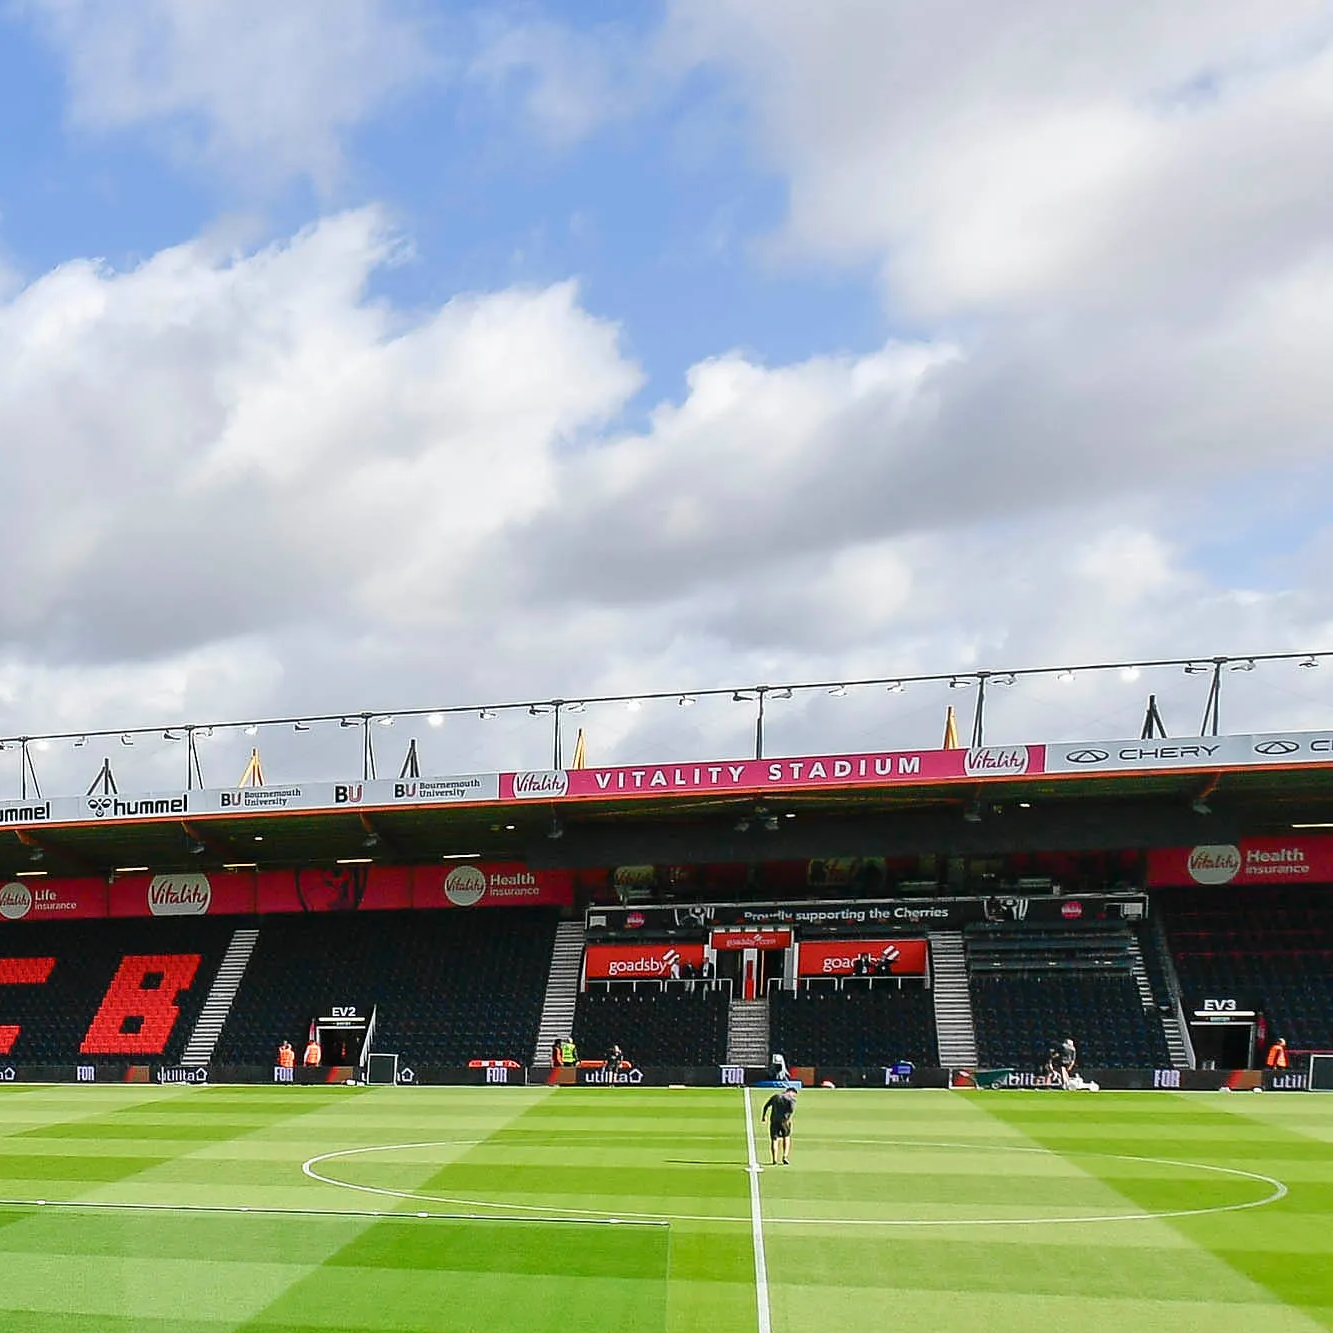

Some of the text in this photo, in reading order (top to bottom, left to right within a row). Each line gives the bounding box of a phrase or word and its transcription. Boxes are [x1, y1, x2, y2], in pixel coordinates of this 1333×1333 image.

[967, 746, 1027, 772] Vitality
[1119, 745, 1220, 760] CHERY
[595, 756, 920, 790] VITALITY STADIUM
[395, 783, 416, 798] BU
[420, 779, 480, 789] Bournemouth
[514, 771, 567, 795] Vitality
[221, 792, 241, 807] BU
[245, 788, 301, 798] Bournemouth
[335, 784, 363, 803] BU
[113, 794, 187, 816] hummel
[1247, 848, 1305, 862] Health
[490, 872, 535, 886] Health
[35, 889, 57, 900] Life
[150, 880, 209, 911] Vitality
[796, 909, 867, 922] supporting
[870, 908, 890, 919] the
[609, 957, 667, 976] goadsby
[332, 1006, 356, 1017] EV2
[1204, 999, 1237, 1011] EV3
